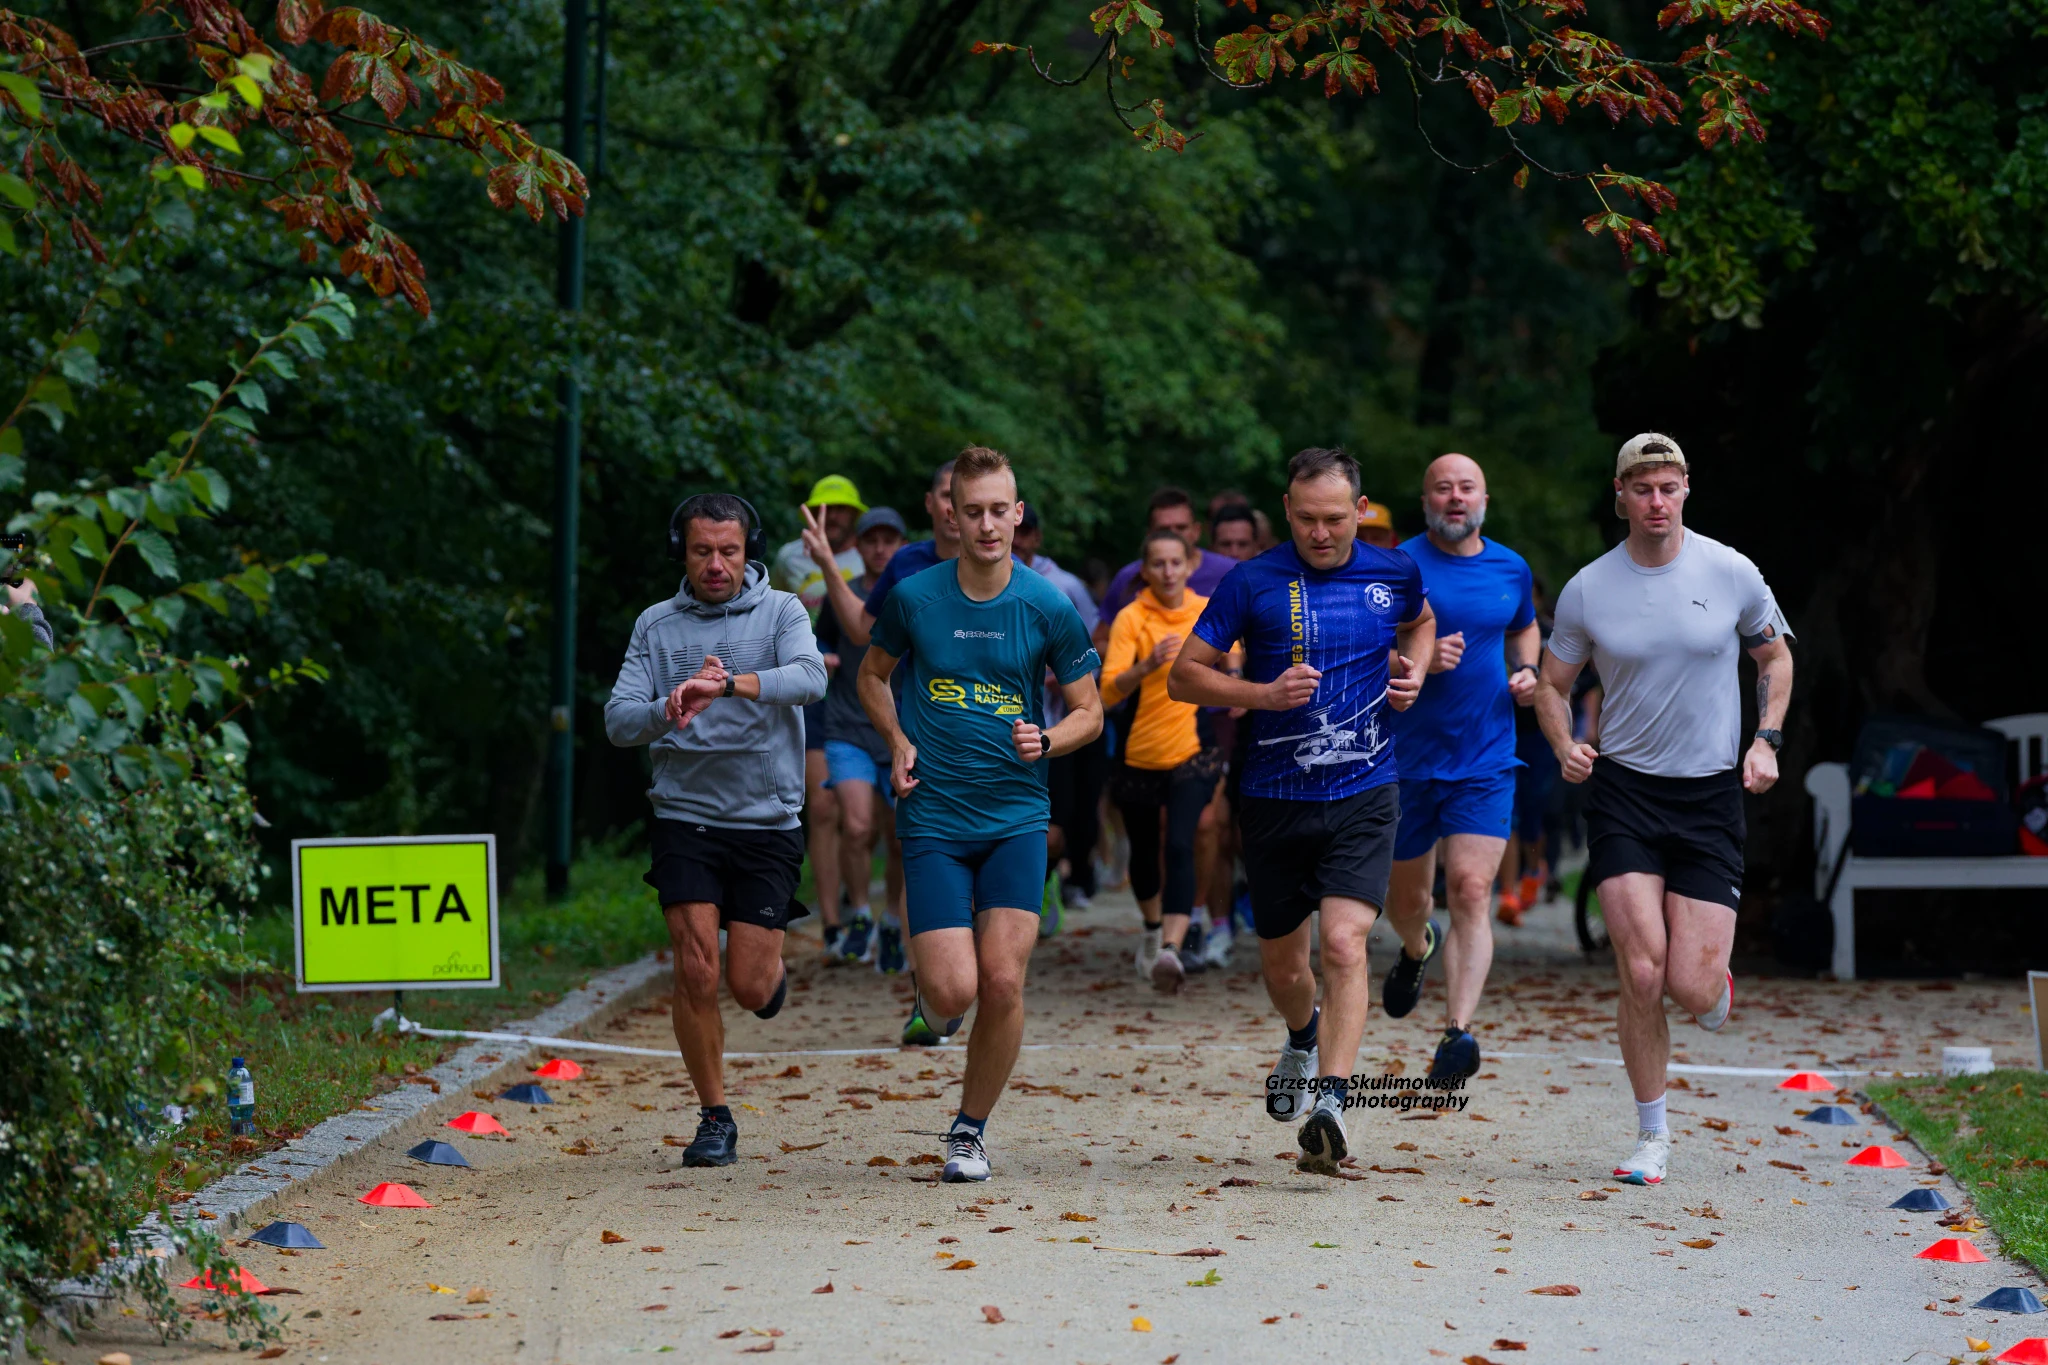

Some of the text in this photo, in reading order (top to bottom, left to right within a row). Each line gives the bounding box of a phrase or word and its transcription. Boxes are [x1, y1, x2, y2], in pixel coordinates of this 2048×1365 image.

[1372, 587, 1391, 608] 85
[1288, 580, 1304, 668] IEG LOTNIKA
[974, 683, 1001, 694] RUN
[974, 694, 1024, 704] RADICAL
[320, 883, 472, 926] META
[432, 957, 485, 976] parkrun
